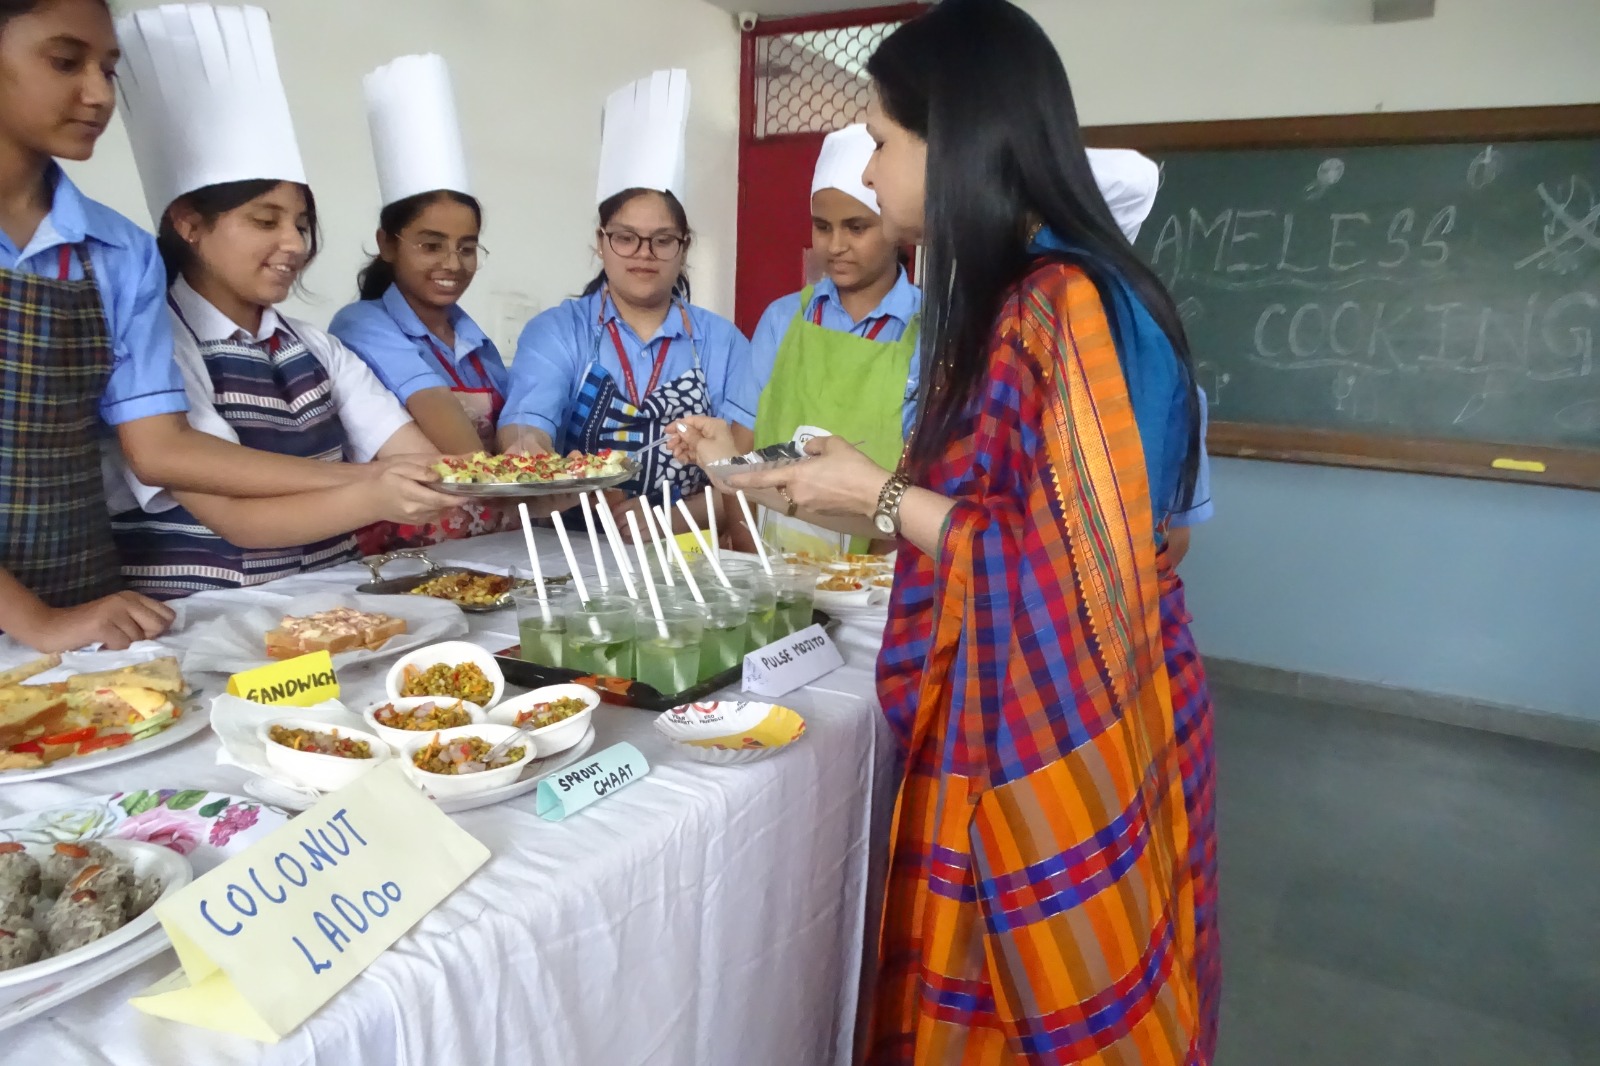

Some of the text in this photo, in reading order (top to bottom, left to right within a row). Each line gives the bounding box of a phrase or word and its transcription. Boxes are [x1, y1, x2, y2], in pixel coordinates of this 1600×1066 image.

[1253, 290, 1599, 377] COOKING
[761, 635, 825, 670] PULSE MOJITO
[246, 668, 337, 704] SANDWICH
[558, 762, 603, 792] SPROUT
[593, 764, 633, 796] CHAAT
[200, 809, 367, 936] COCONUT
